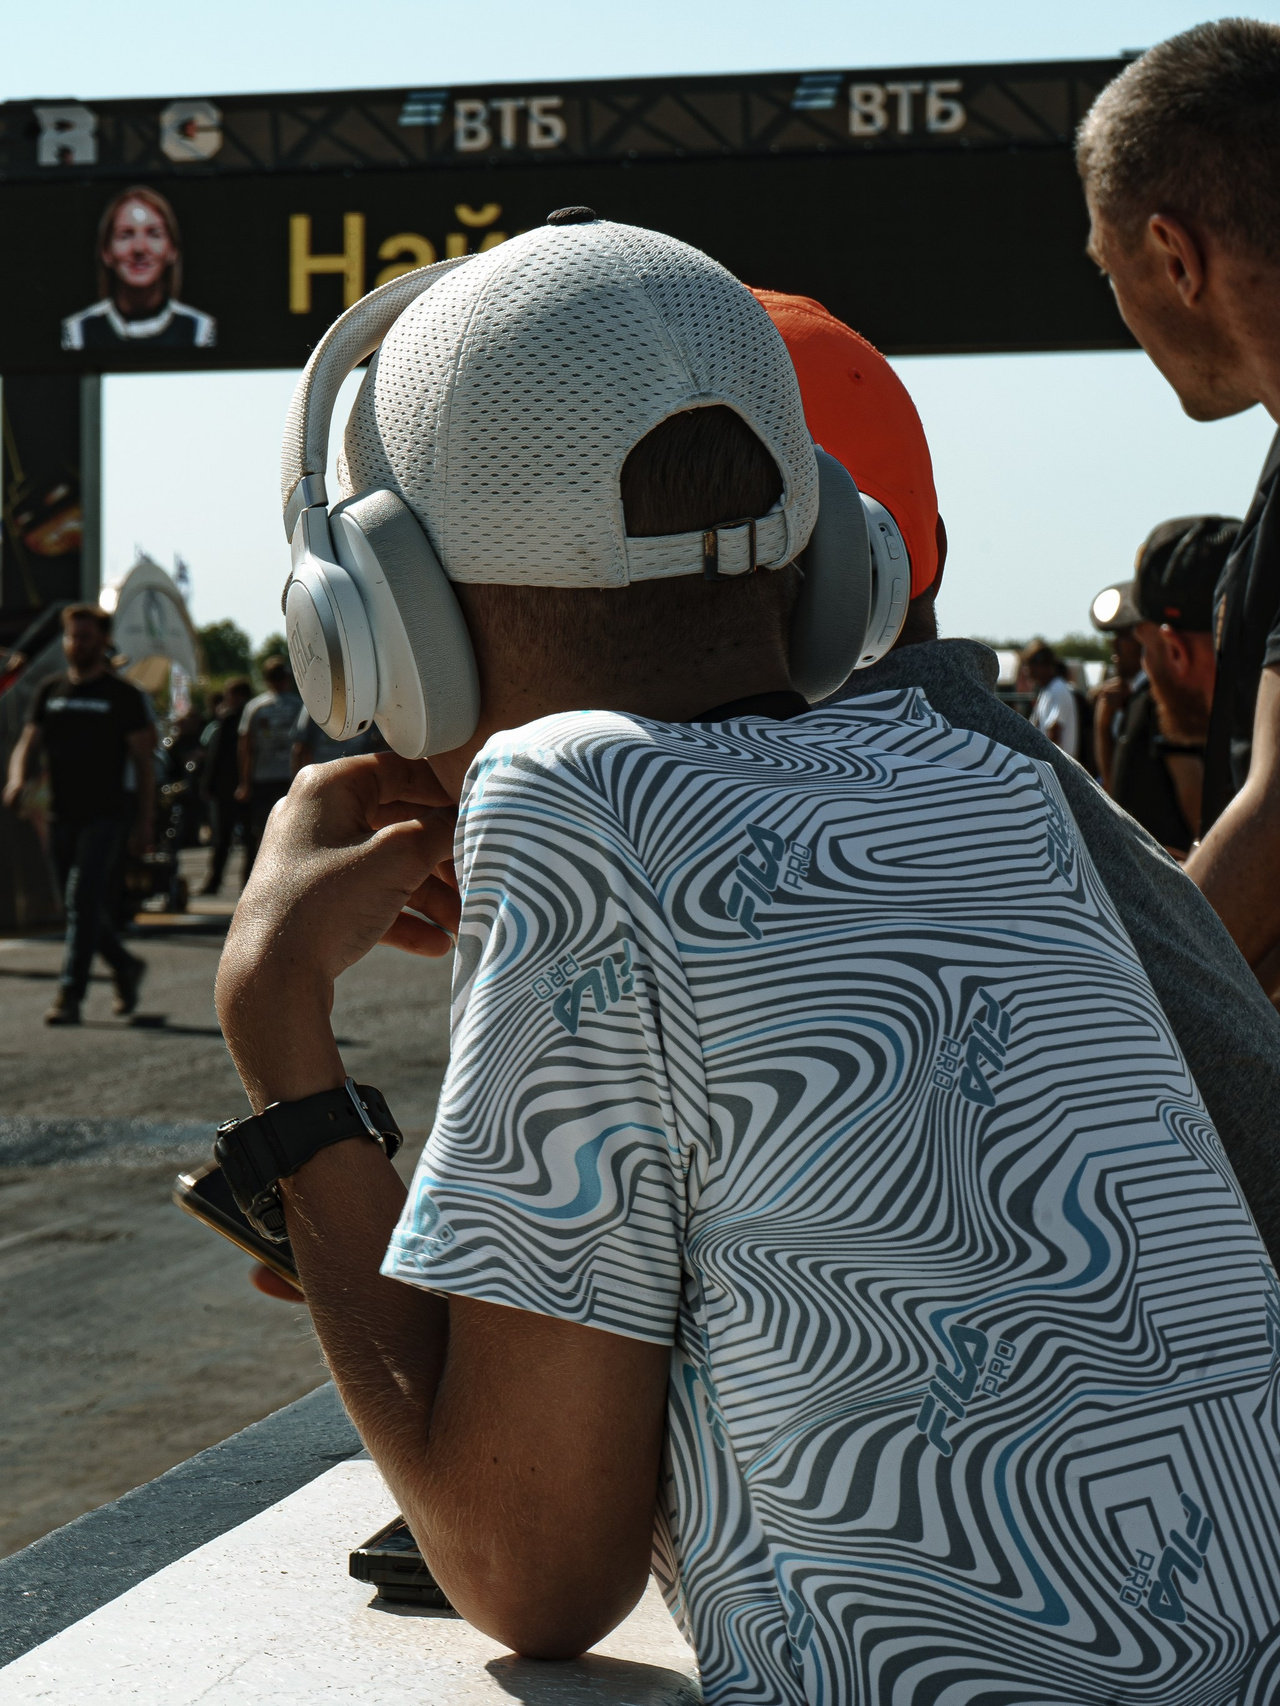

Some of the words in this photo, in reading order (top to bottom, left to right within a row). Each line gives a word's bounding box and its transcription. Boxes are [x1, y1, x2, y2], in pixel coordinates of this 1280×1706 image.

[453, 98, 567, 152] ВТБ
[848, 80, 966, 136] ВТБ
[725, 823, 785, 941] FILA
[782, 840, 813, 891] PRO
[531, 952, 581, 1000] PRO
[932, 1035, 963, 1091] PRO
[959, 986, 1012, 1108] FILA
[916, 1323, 989, 1457] FILA
[980, 1339, 1017, 1398] PRO
[1120, 1548, 1156, 1608] PRO
[1147, 1492, 1213, 1624] FILA
